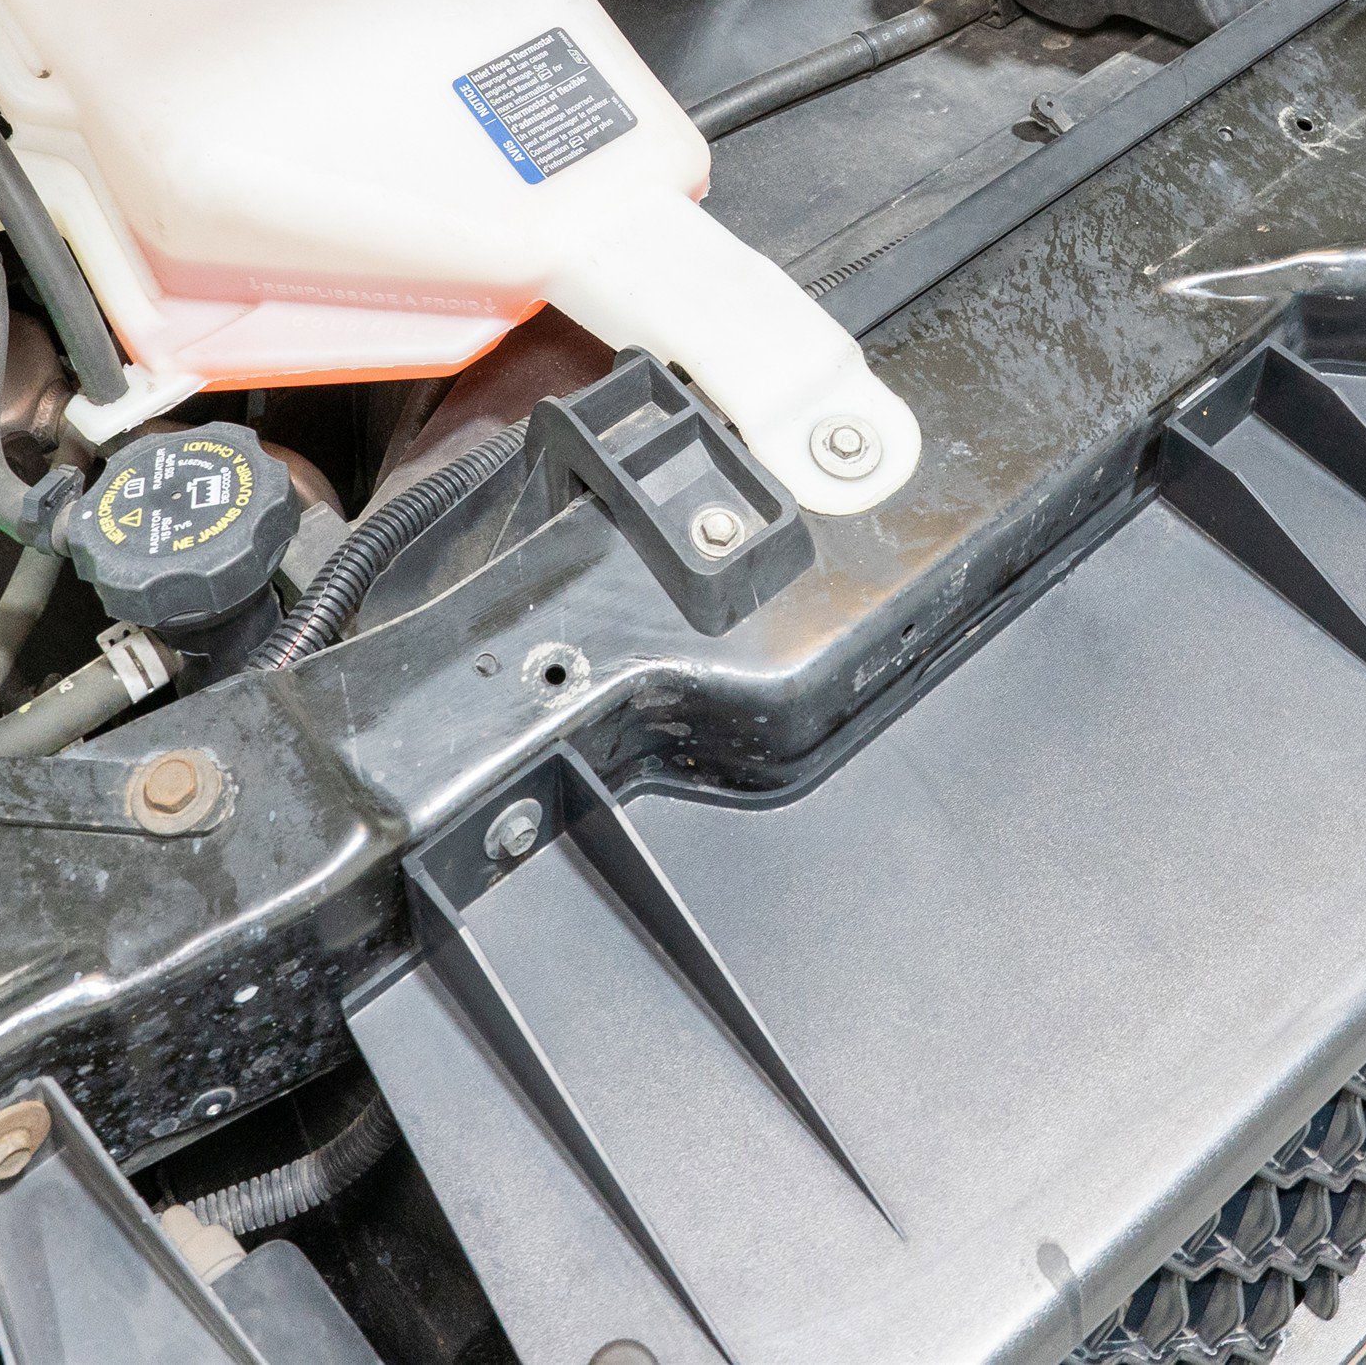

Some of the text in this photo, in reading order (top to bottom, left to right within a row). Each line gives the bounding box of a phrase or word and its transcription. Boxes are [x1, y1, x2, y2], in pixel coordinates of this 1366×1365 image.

[471, 68, 491, 82] Inlet
[489, 59, 511, 73] Hose
[509, 35, 554, 62] Thermostat
[478, 51, 549, 90] Improper fill can cause
[485, 62, 547, 98] engine damage. See
[490, 63, 563, 106] Service Manual for
[497, 82, 552, 114] more information.
[459, 83, 489, 118] NOTICE
[503, 76, 587, 124] Thermostat et flexible
[511, 104, 559, 133] d'admission
[516, 95, 594, 141] Un remplissage incorrect
[524, 137, 540, 151] peut
[539, 116, 579, 141] endommager
[586, 98, 610, 115] moteur.
[529, 138, 560, 157] Consulter
[567, 119, 592, 137] manuel
[591, 115, 601, 123] de
[536, 118, 614, 165] réparation pour plus
[503, 139, 525, 162] AVIS
[543, 147, 587, 173] d'information.
[262, 281, 399, 304] REMPLISSAGE
[422, 295, 479, 311] FROID
[292, 314, 359, 332] COLD
[153, 447, 166, 490] RADIATEUR
[98, 490, 116, 516] OPEN
[172, 536, 194, 551] NE
[197, 507, 241, 543] JAMAIS
[235, 463, 253, 506] OUVRIR
[99, 515, 127, 544] NEVER
[149, 509, 161, 554] RADIATOR
[161, 516, 172, 541] 15 PSI
